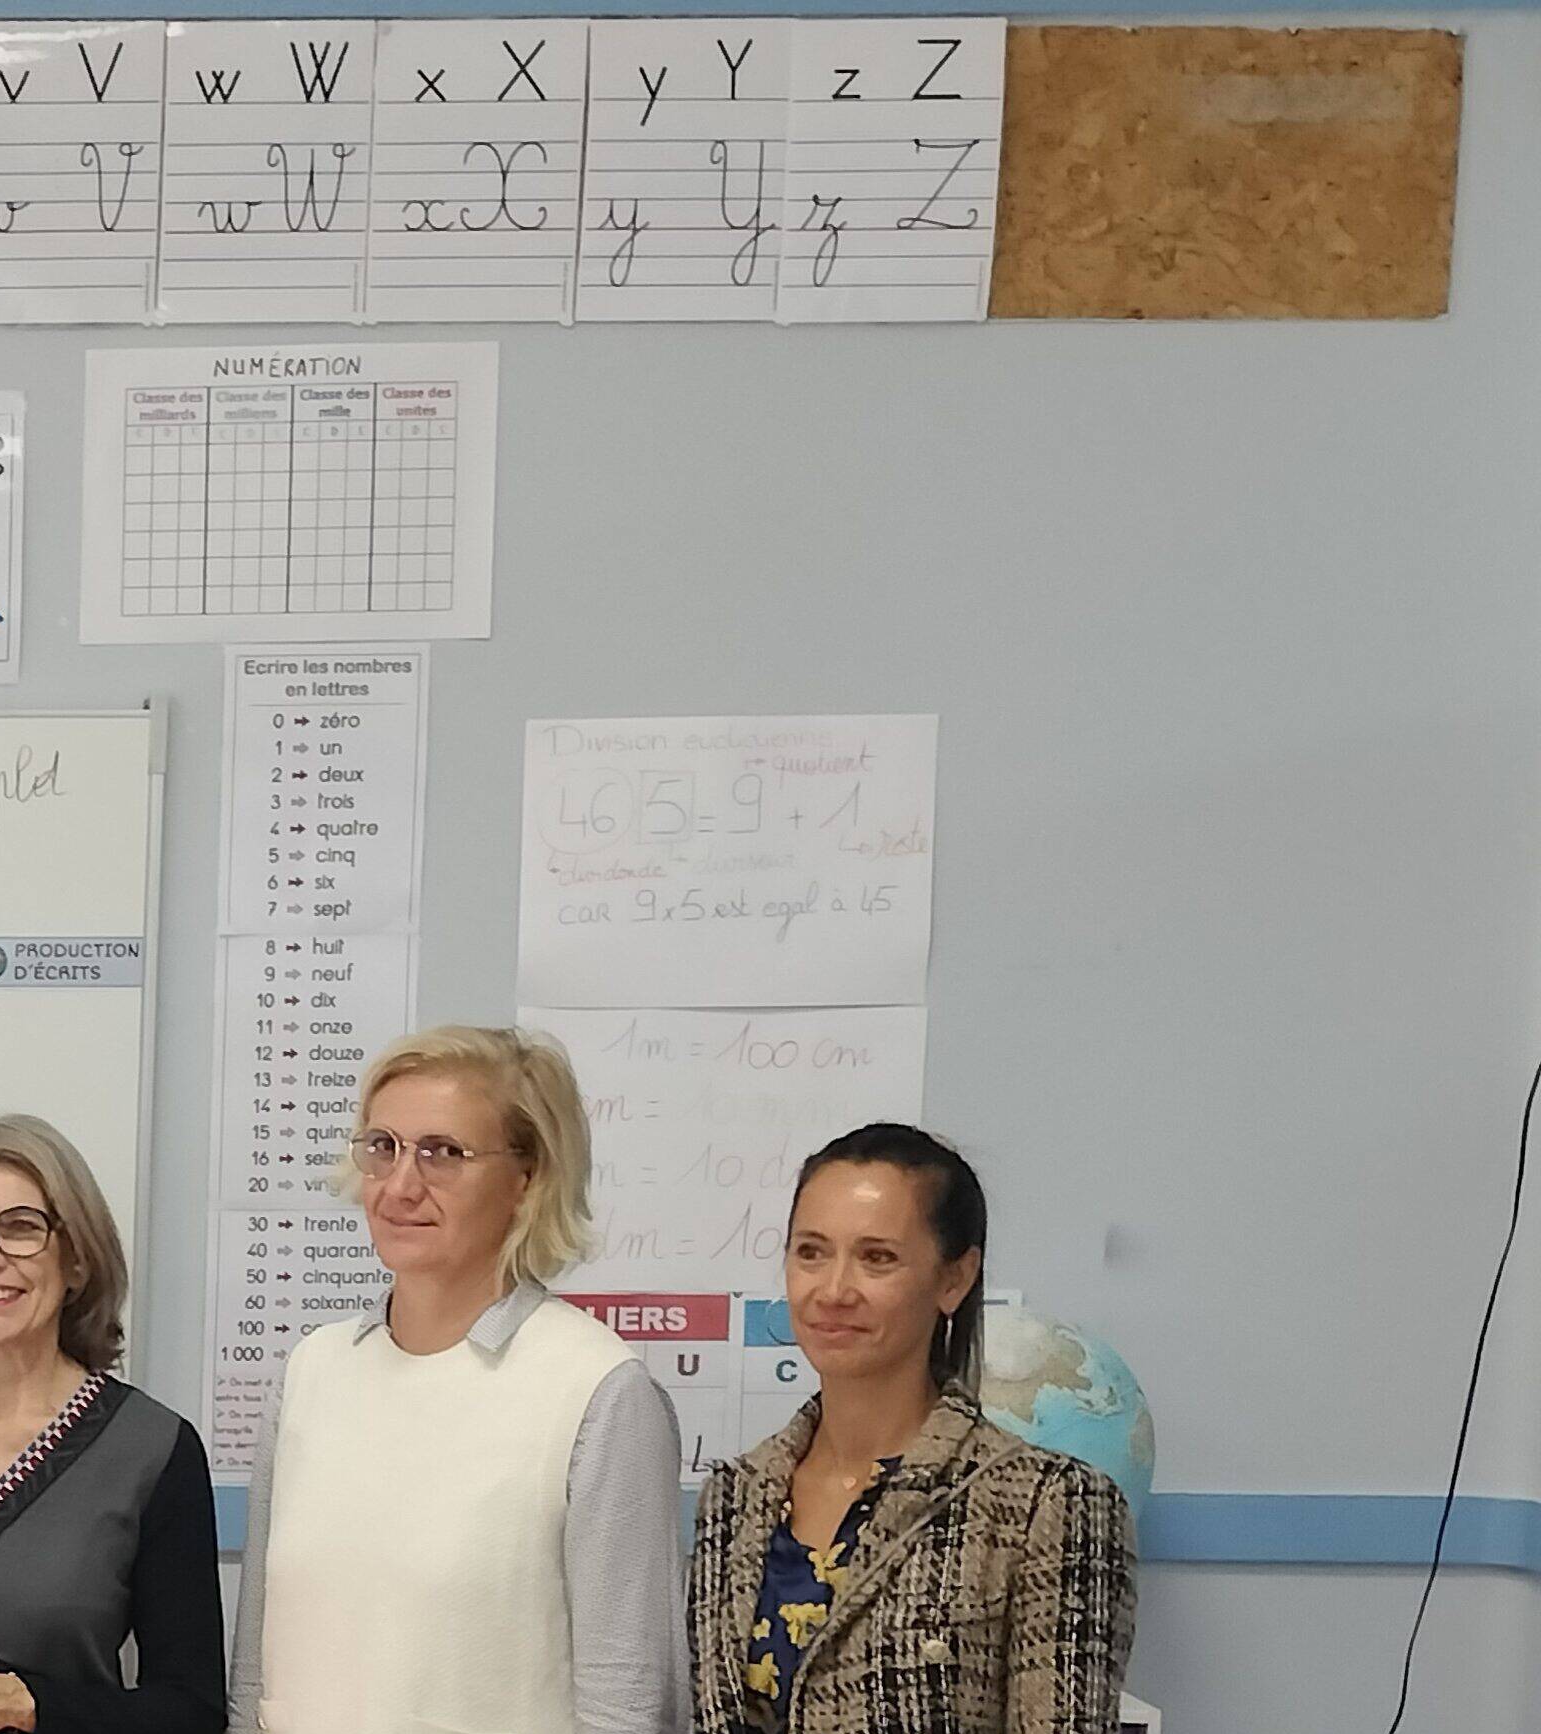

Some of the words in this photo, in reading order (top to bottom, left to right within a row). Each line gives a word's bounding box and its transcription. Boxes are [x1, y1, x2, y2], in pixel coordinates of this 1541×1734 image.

[214, 353, 361, 377] NUMÉRATION
[382, 387, 425, 399] Classe
[430, 387, 452, 398] des
[244, 659, 298, 675] Ecrire
[303, 659, 328, 673] les
[334, 659, 412, 673] nombres
[286, 685, 307, 697] en
[312, 682, 369, 697] lettres
[273, 713, 284, 728] 0
[320, 713, 360, 728] zéro
[276, 741, 282, 755] 1
[320, 742, 342, 756] un
[271, 768, 282, 783] 2
[319, 767, 364, 783] deux
[270, 794, 280, 809] 3
[317, 794, 355, 809] trois
[270, 821, 280, 836] 4
[317, 821, 378, 840] quatre
[268, 848, 279, 863] 5
[316, 849, 355, 867] cinq
[267, 875, 278, 890] 6
[314, 875, 335, 890] six
[267, 902, 277, 916] 7
[313, 901, 352, 920] sept
[14, 942, 140, 960] PRODUCTION
[265, 940, 276, 955] 8
[312, 939, 344, 955] huit
[14, 961, 101, 980] D'ÉCRITS
[264, 967, 275, 982] 9
[311, 964, 354, 981] neuf
[257, 994, 275, 1008] 10
[311, 993, 336, 1008] dix
[256, 1020, 273, 1034] 11
[310, 1021, 352, 1035] onze
[255, 1047, 272, 1061] 12
[309, 1046, 364, 1061] douze
[254, 1073, 271, 1087] 13
[307, 1072, 356, 1087] treize
[253, 1099, 270, 1113] 14
[252, 1125, 270, 1140] 15
[252, 1151, 269, 1166] 16
[248, 1177, 269, 1192] 20
[248, 1217, 268, 1232] 30
[304, 1216, 358, 1232] trente
[247, 1243, 267, 1258] 40
[246, 1270, 266, 1284] 50
[302, 1269, 393, 1288] cinquante
[245, 1296, 265, 1310] 60
[301, 1294, 375, 1311] soixante
[237, 1321, 264, 1336] 100
[678, 1354, 700, 1376] U
[776, 1360, 798, 1383] C
